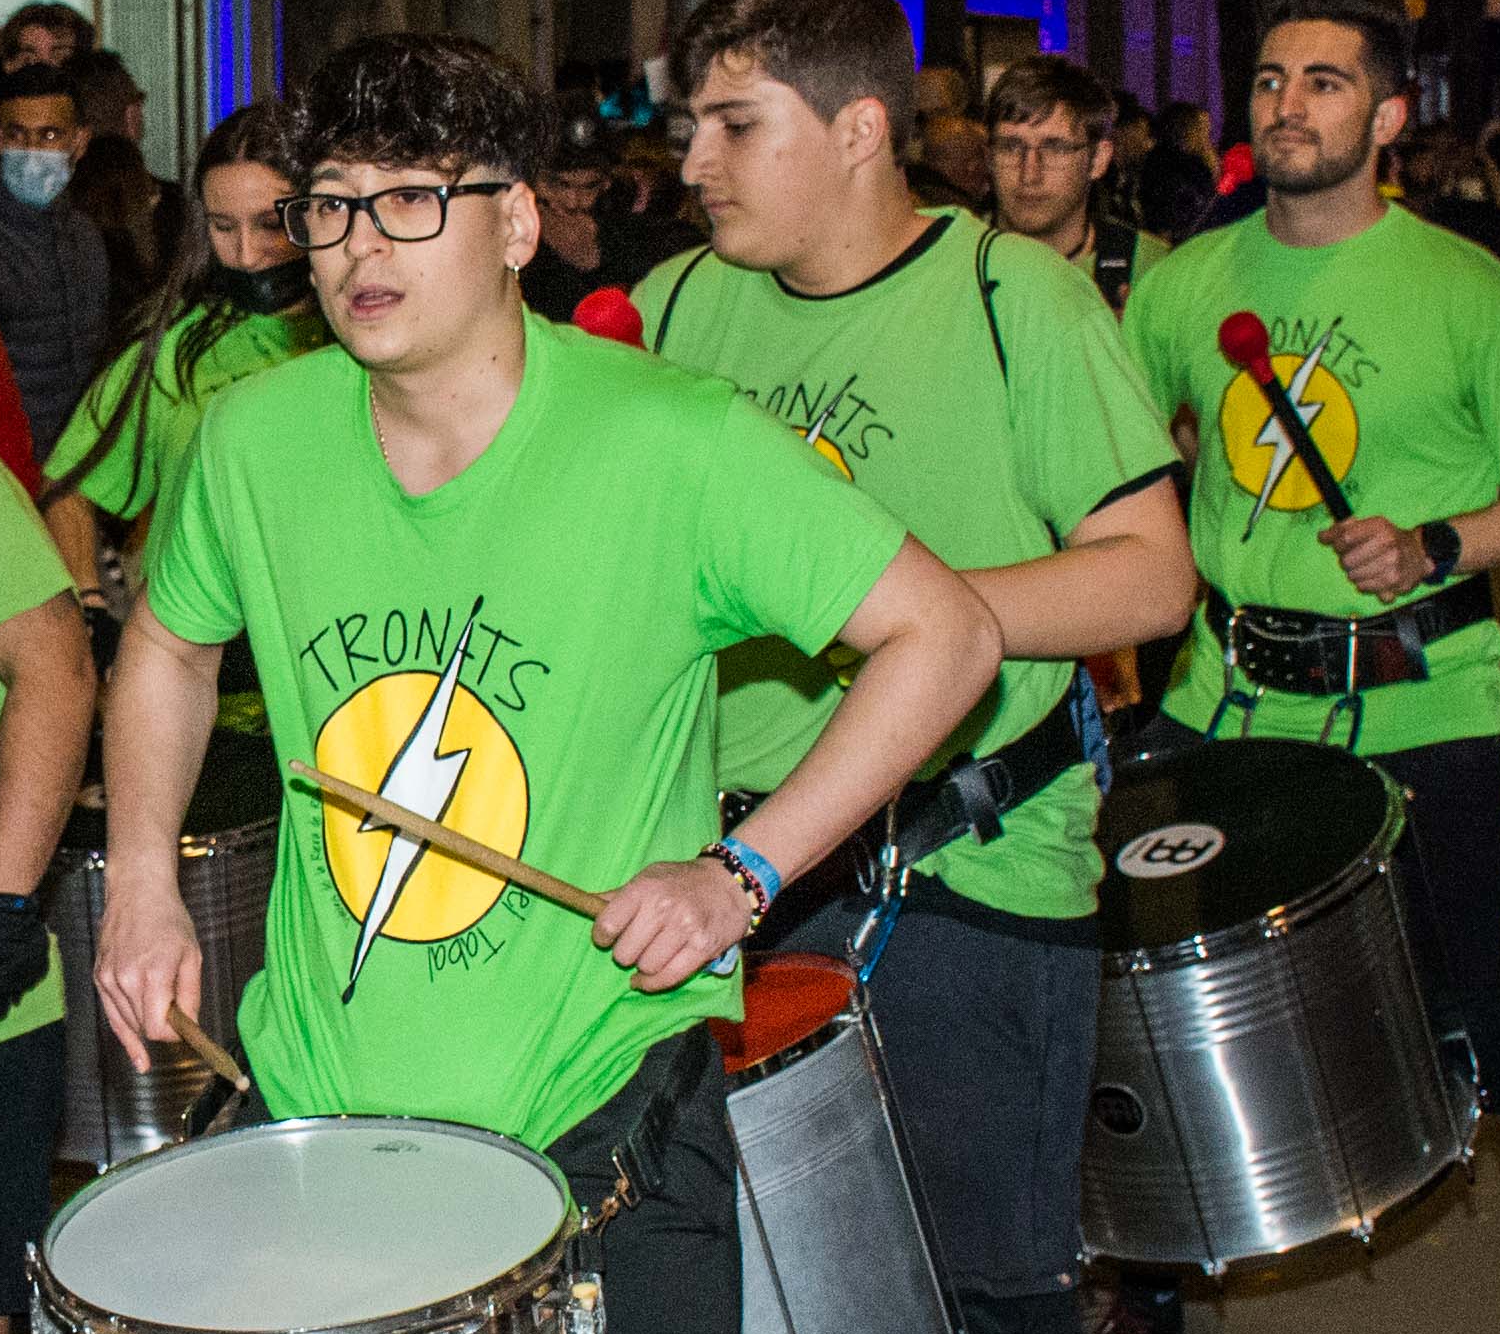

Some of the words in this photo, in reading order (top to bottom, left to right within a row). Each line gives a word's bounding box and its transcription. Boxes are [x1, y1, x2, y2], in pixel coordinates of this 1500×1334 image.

[1271, 316, 1381, 390] ONITS
[298, 595, 552, 713] TRONITS
[426, 927, 506, 984] Tabal
